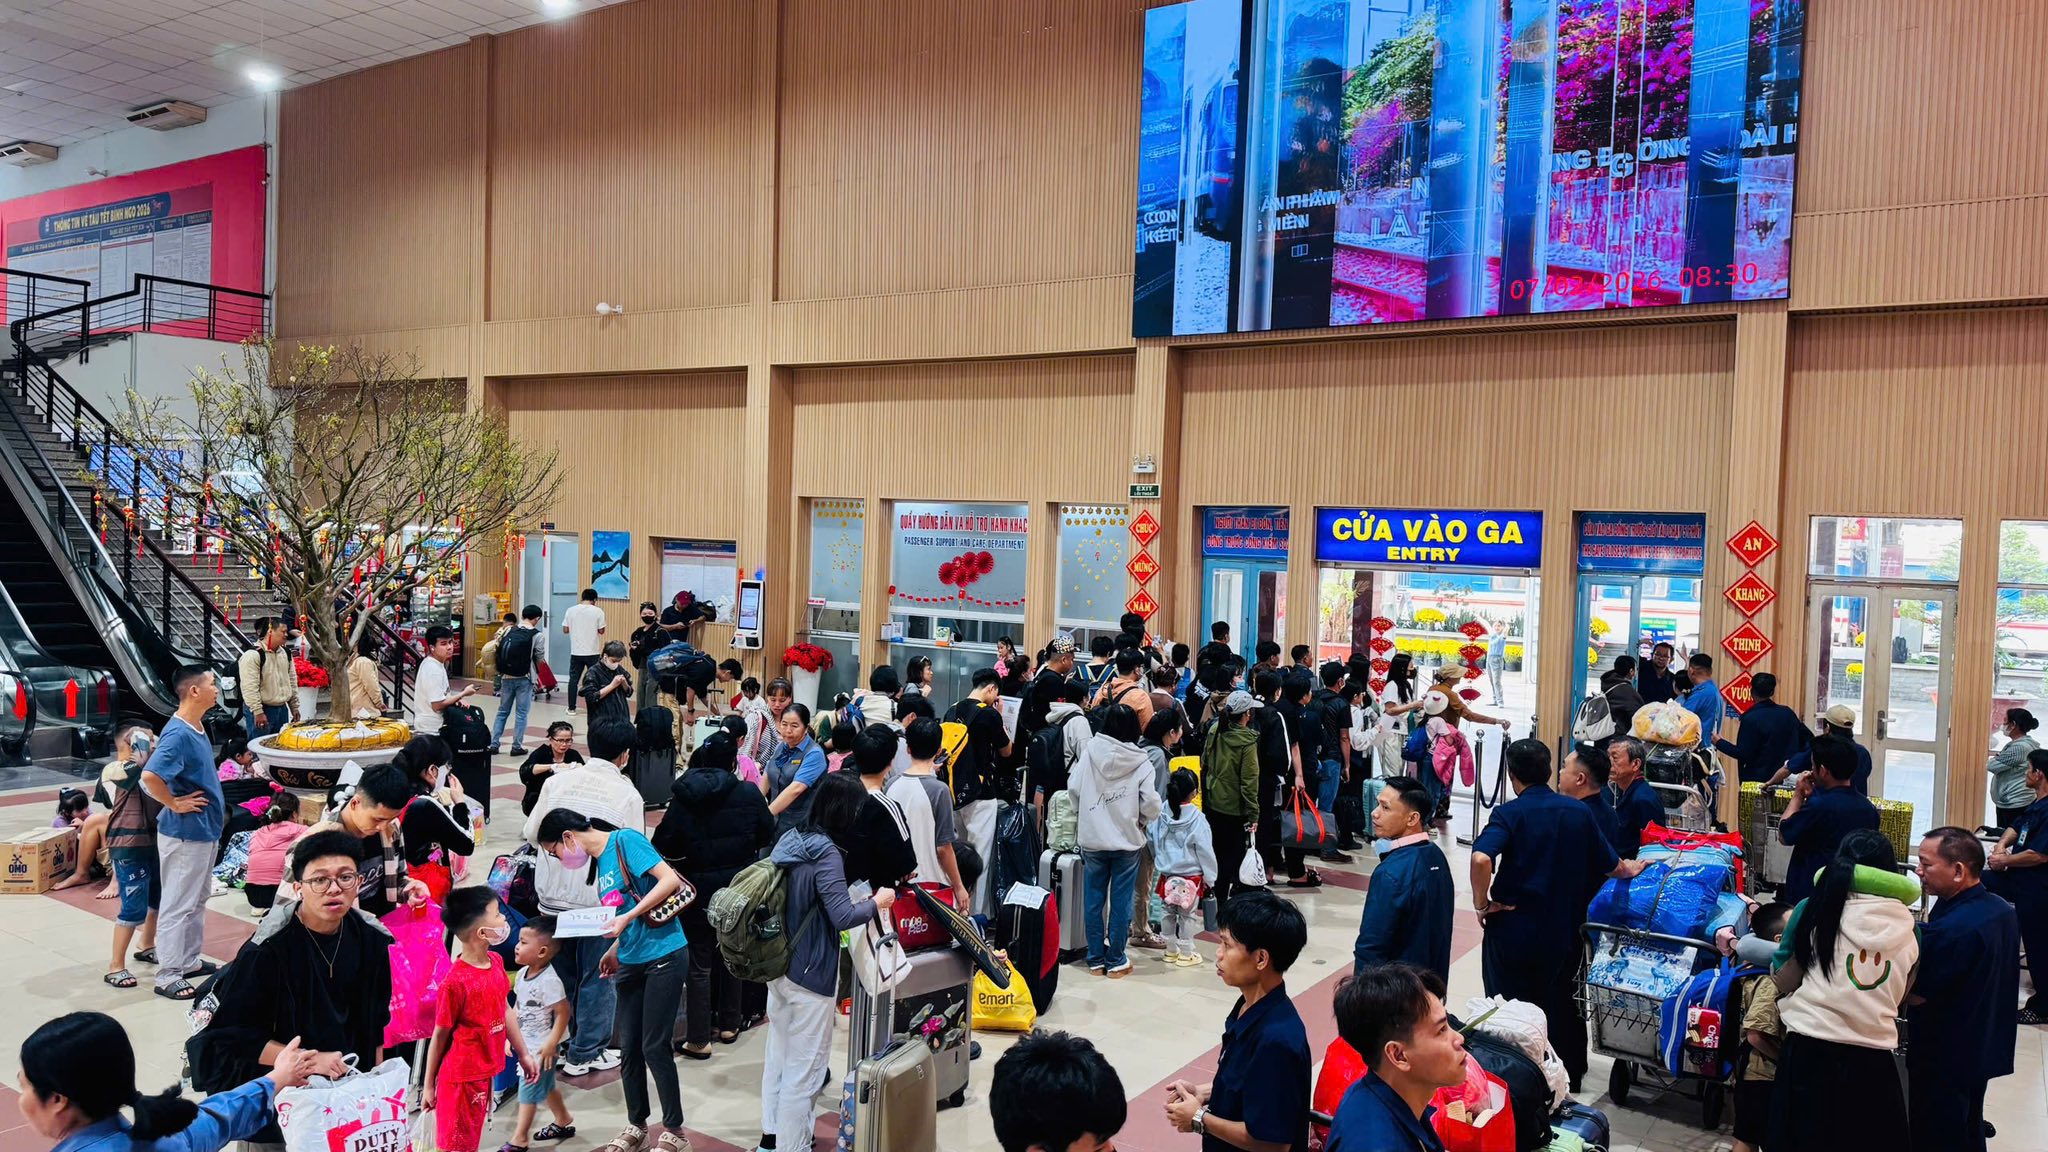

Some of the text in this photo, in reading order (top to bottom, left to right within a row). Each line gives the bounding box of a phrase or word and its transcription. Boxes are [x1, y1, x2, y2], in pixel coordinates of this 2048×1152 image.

[1510, 263, 1758, 300] 07/02/2026 08:30
[940, 510, 953, 530] DẪN
[976, 514, 989, 535] TRỢ
[990, 513, 1008, 532] HÀNH
[1009, 515, 1028, 533] KHÁC
[1135, 520, 1154, 534] CHÚC
[1331, 510, 1524, 544] CỬA VÀO GA
[904, 536, 1025, 549] PASSENGER SUPPORT AND CARE DEPARTMENT
[1743, 537, 1762, 551] AN
[1387, 546, 1461, 562] ENTRY
[1134, 559, 1153, 573] MỪNG
[1735, 587, 1765, 601] KHANG
[1733, 637, 1762, 654] THỊNH
[8, 864, 28, 874] OMO
[978, 992, 1015, 1006] emart
[354, 1127, 400, 1152] DUTY
